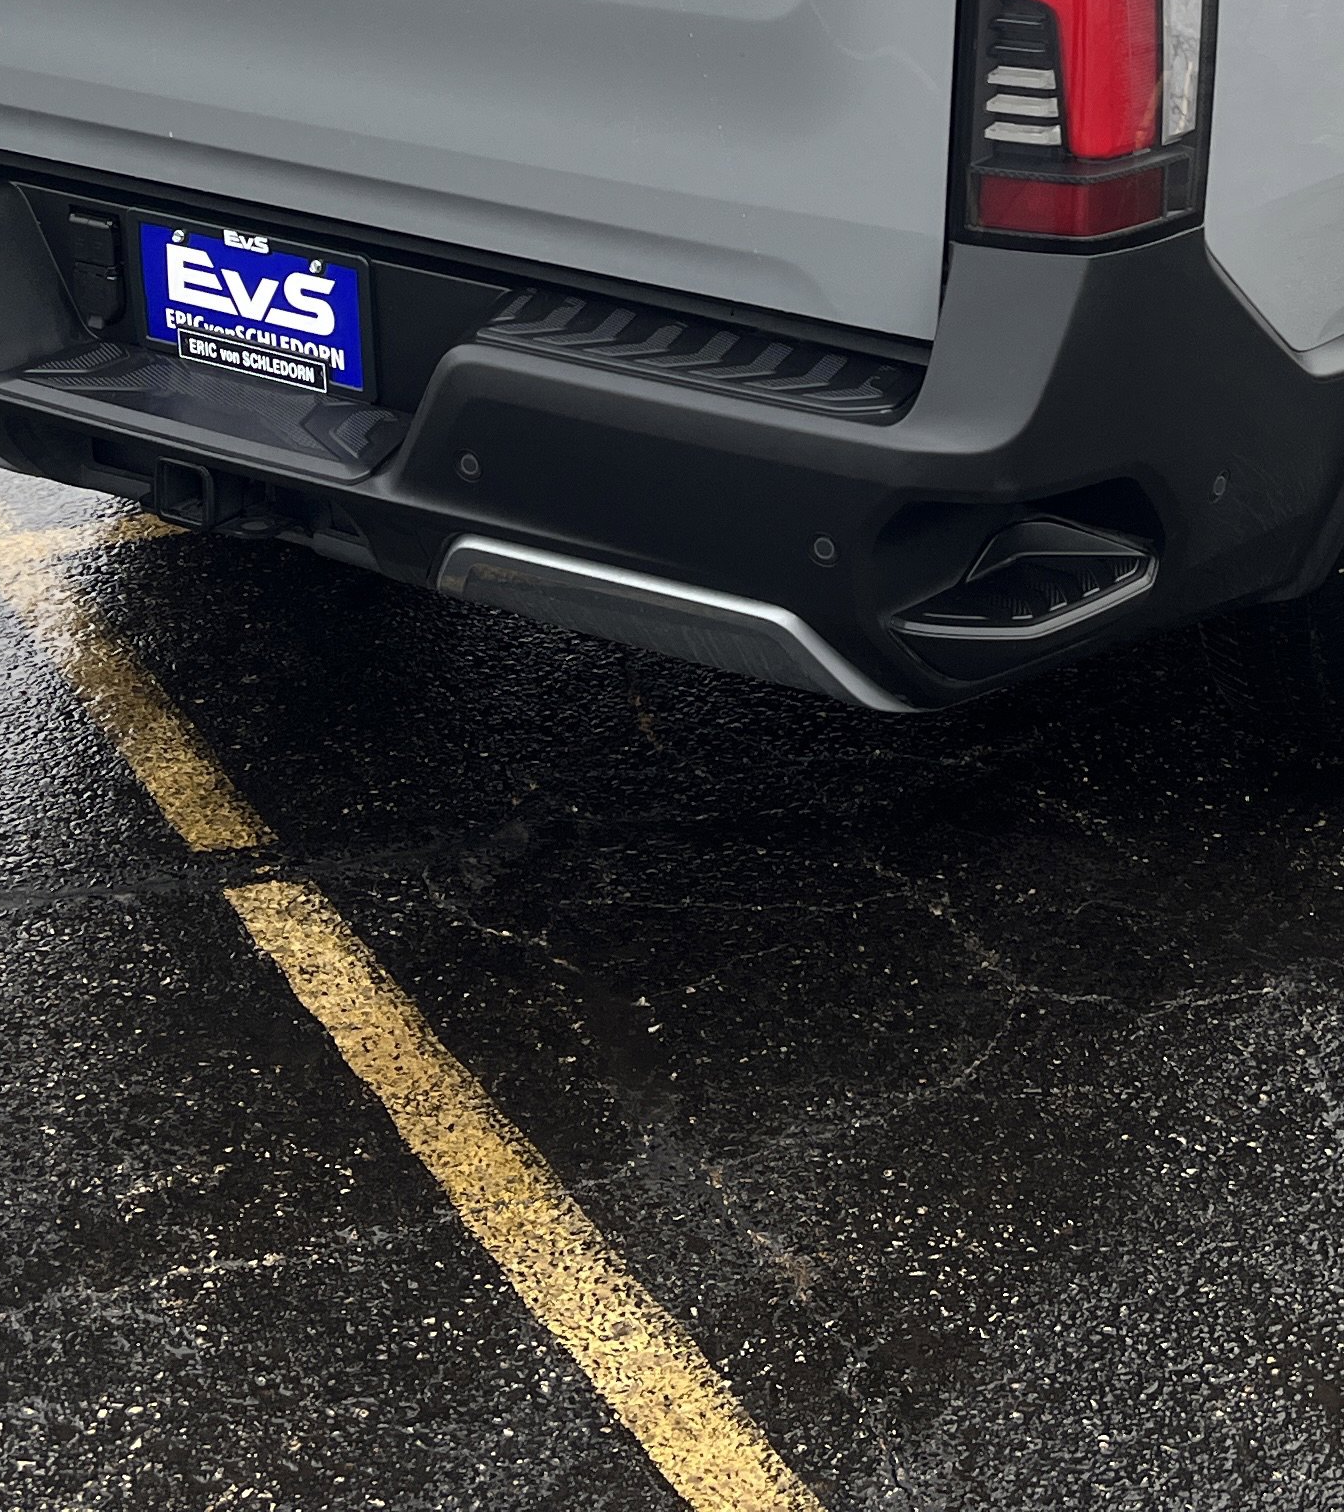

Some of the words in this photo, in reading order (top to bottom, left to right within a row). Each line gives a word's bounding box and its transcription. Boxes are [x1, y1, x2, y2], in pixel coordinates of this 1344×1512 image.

[223, 229, 270, 254] EvS
[166, 243, 336, 336] EvS
[189, 337, 218, 359] ERIC
[219, 348, 241, 365] von
[242, 350, 315, 384] SCHLEDORN
